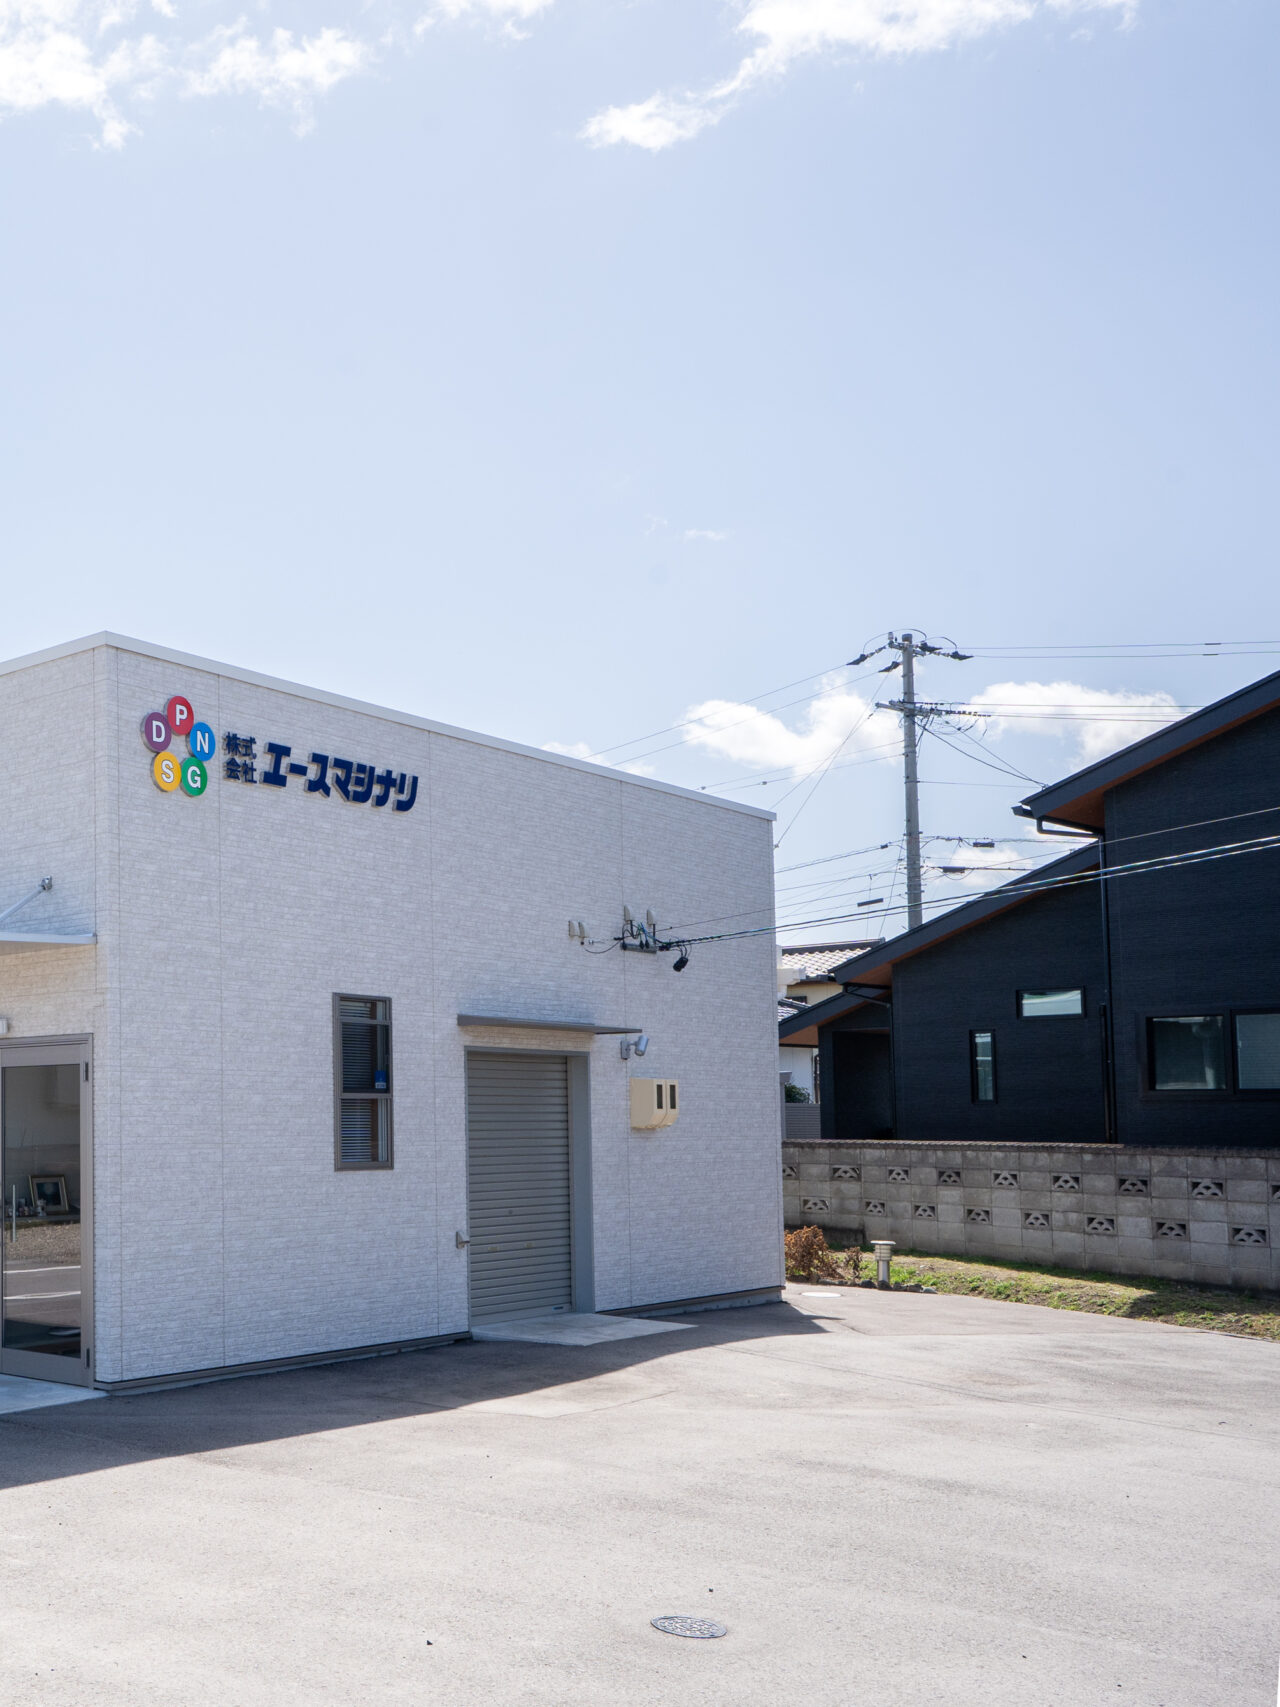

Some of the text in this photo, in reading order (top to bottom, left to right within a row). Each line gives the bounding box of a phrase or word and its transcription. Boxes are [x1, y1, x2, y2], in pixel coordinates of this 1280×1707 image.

[175, 704, 188, 726] P
[152, 720, 166, 743] D
[196, 730, 209, 754] N
[161, 759, 174, 783] S
[187, 765, 201, 789] G
[262, 742, 418, 812] エースマシナリ
